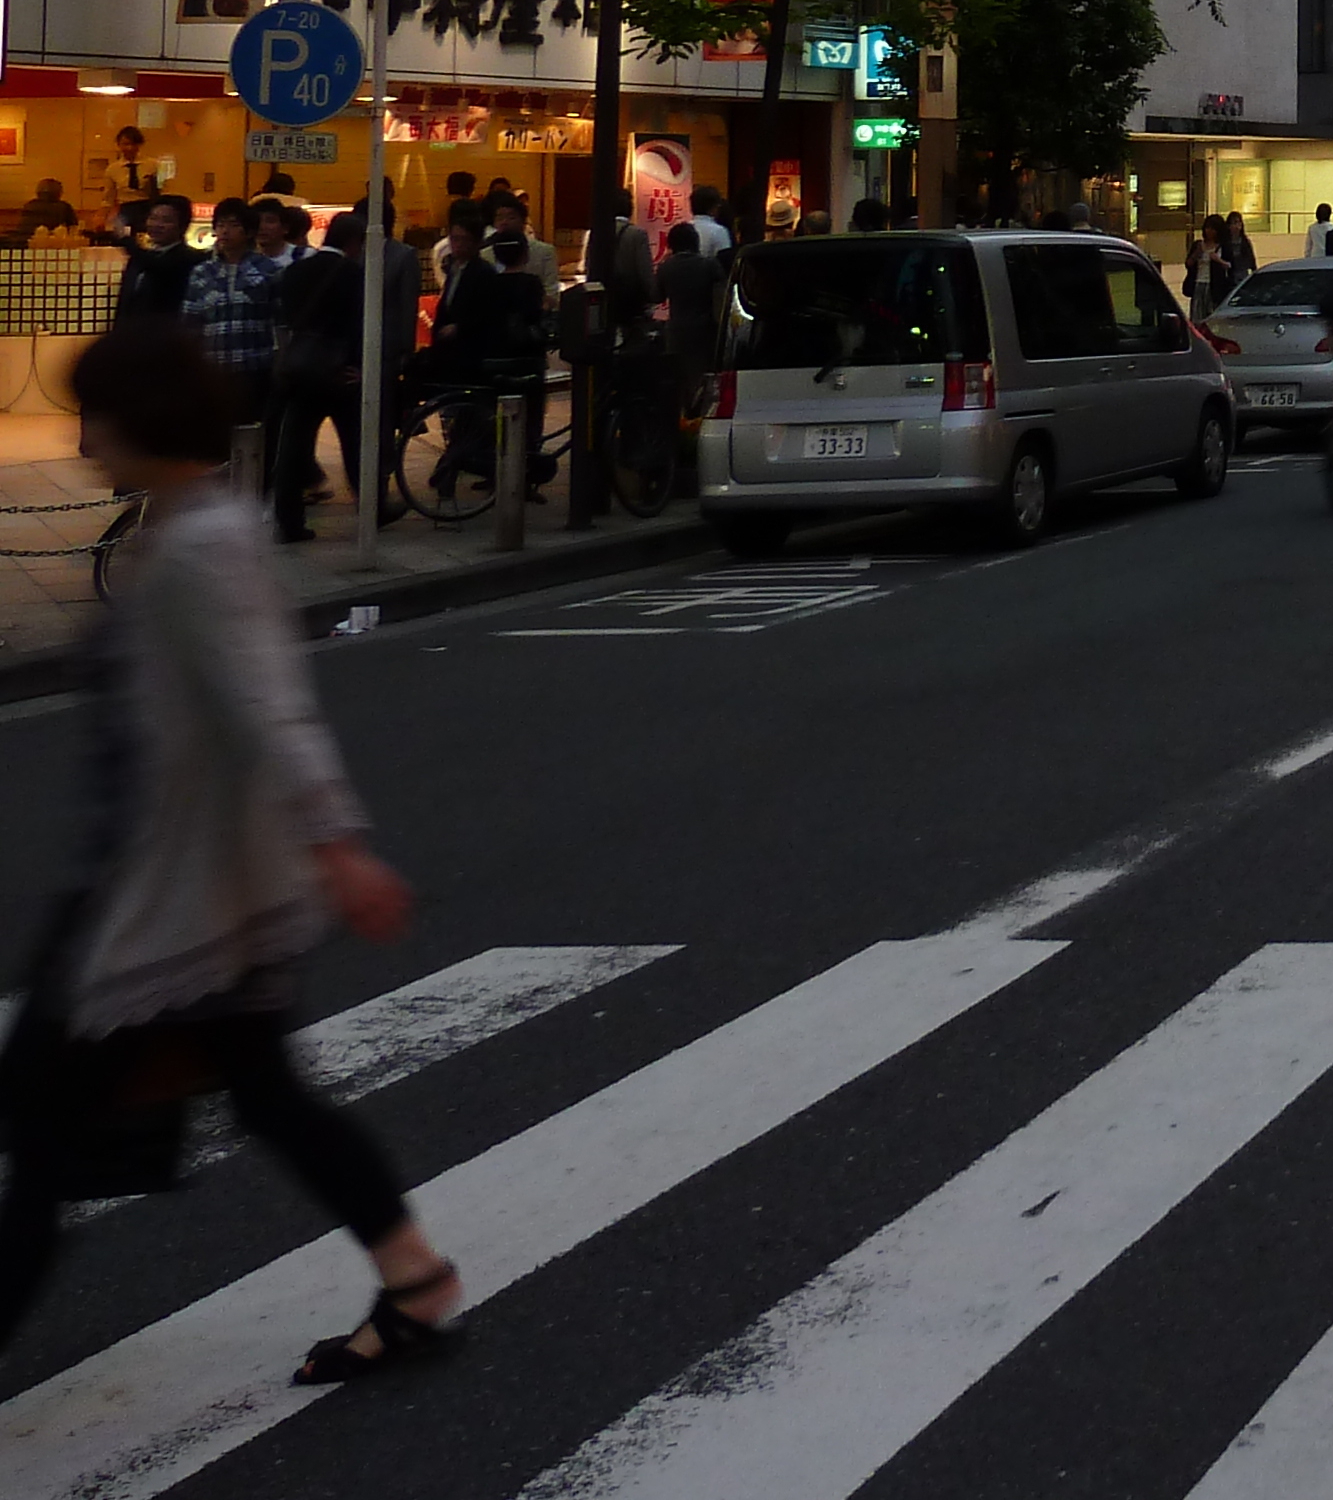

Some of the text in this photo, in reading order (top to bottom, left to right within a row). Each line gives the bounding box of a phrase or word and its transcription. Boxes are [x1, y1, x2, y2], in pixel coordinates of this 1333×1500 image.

[277, 9, 321, 30] 7-20
[258, 29, 310, 106] P
[292, 73, 331, 107] 40
[817, 437, 864, 455] 33-33
